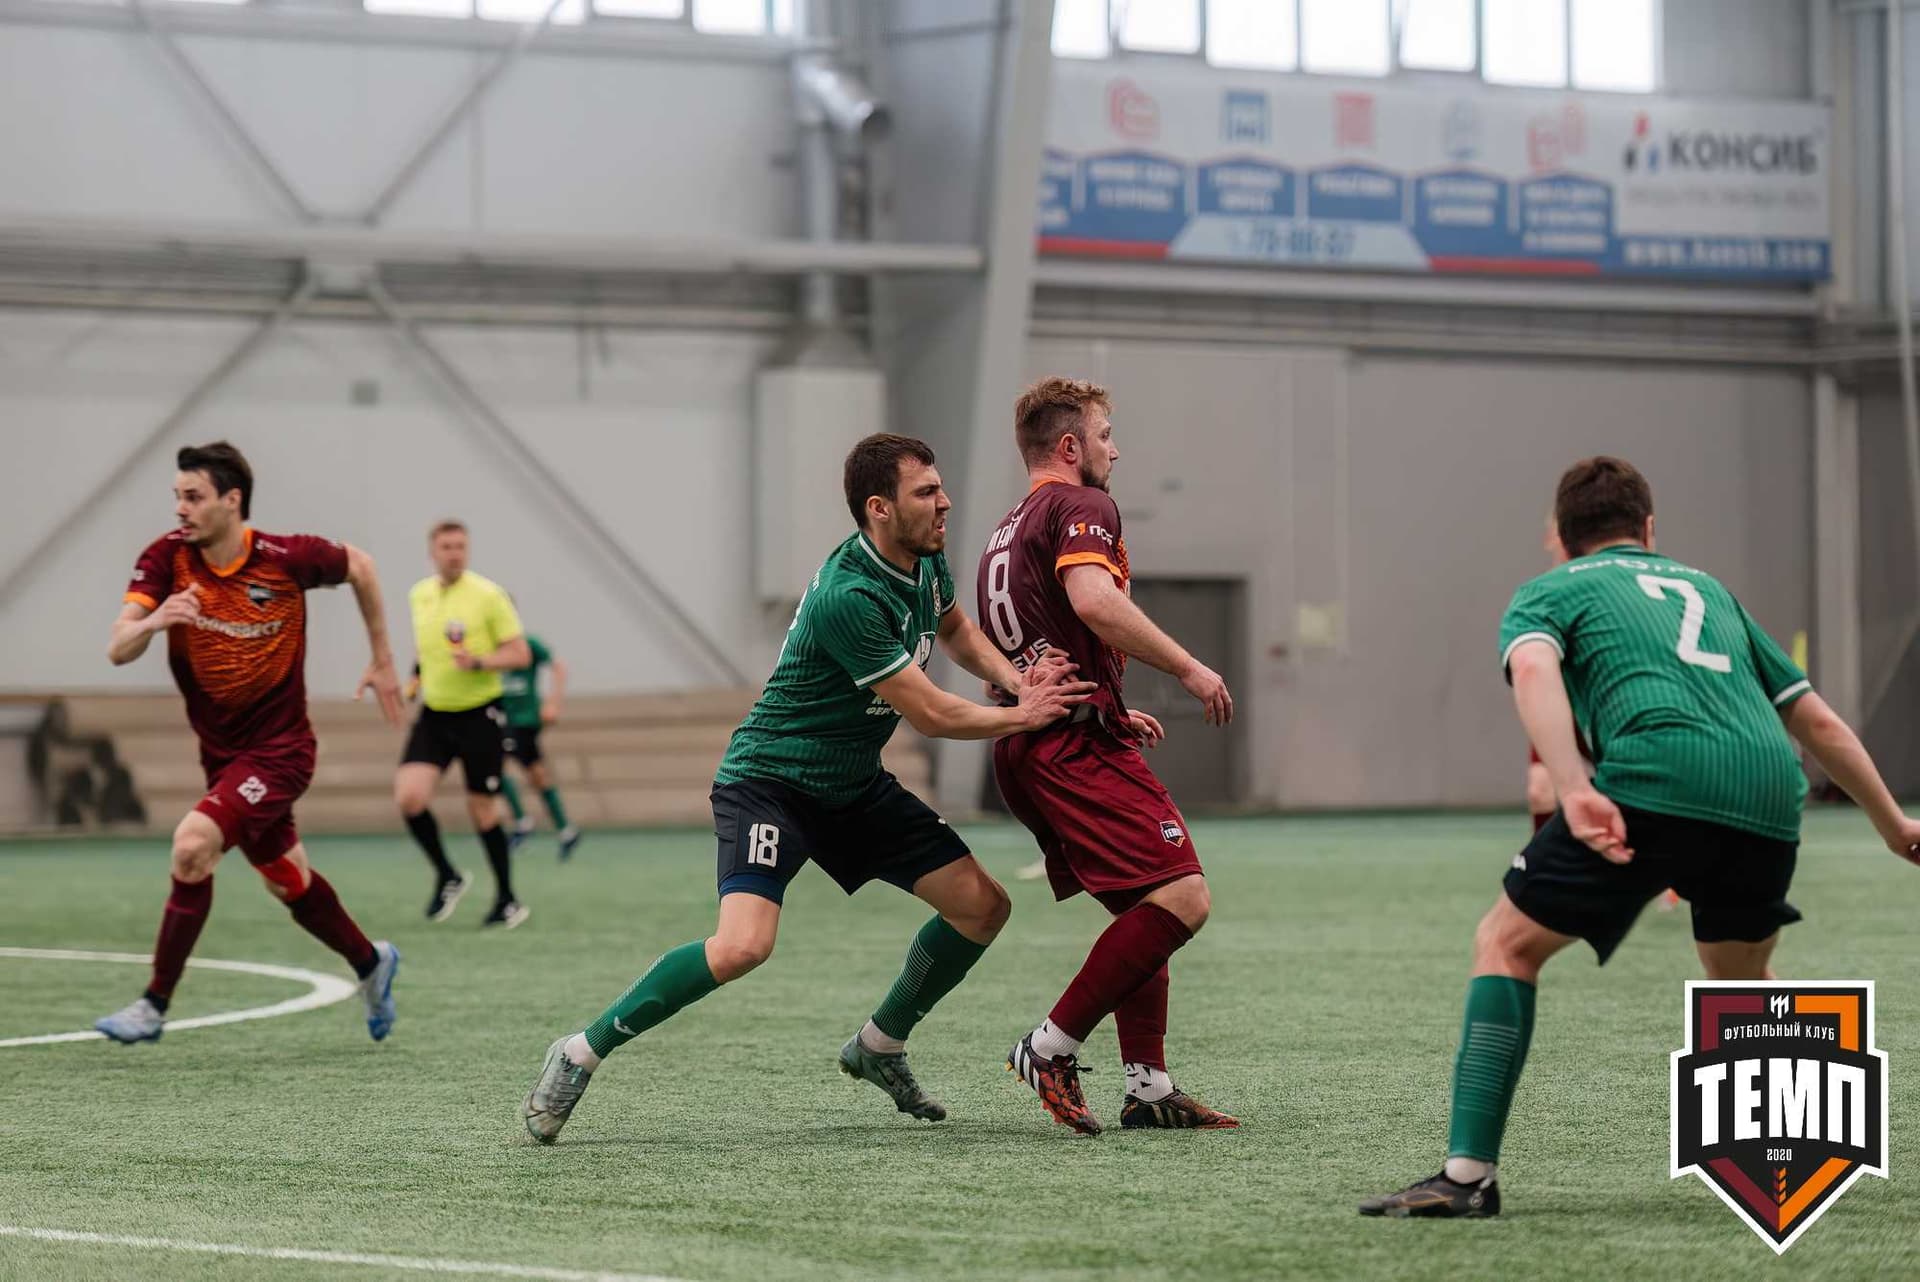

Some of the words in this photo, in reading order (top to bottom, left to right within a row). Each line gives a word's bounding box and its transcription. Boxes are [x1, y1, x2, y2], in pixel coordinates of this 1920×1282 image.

[988, 550, 1023, 651] 8
[1636, 573, 1731, 673] 2
[748, 823, 780, 868] 18
